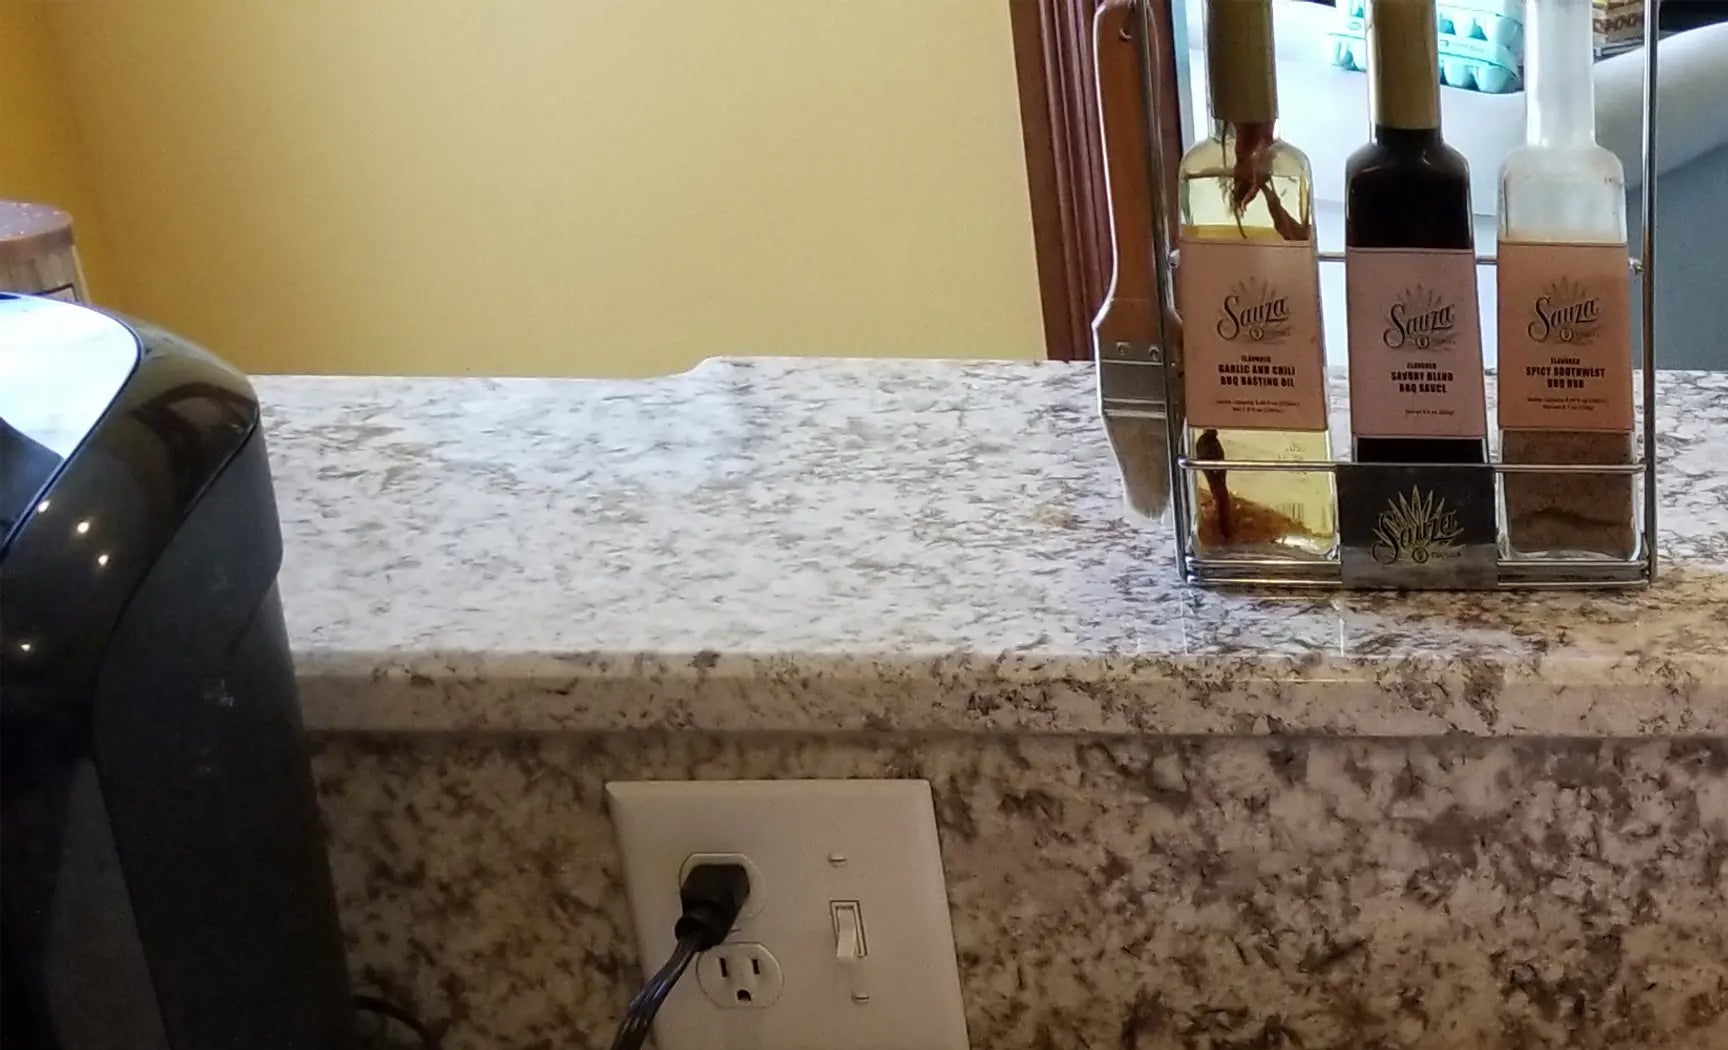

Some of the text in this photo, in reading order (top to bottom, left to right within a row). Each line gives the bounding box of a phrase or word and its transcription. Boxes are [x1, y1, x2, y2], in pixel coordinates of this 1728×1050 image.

[1216, 294, 1291, 341] Sauza
[1528, 296, 1600, 343] Sauza
[1383, 303, 1456, 349] Sauza
[1217, 364, 1296, 376] GARLIC AND CHILI
[1390, 371, 1454, 382] SAVORY BLEND
[1525, 366, 1606, 378] SPICY SOUTHWEST
[1220, 375, 1295, 388] BBQ BASTING OIL
[1399, 383, 1448, 394] BBQ SAUCE
[1371, 509, 1464, 565] Sauza
